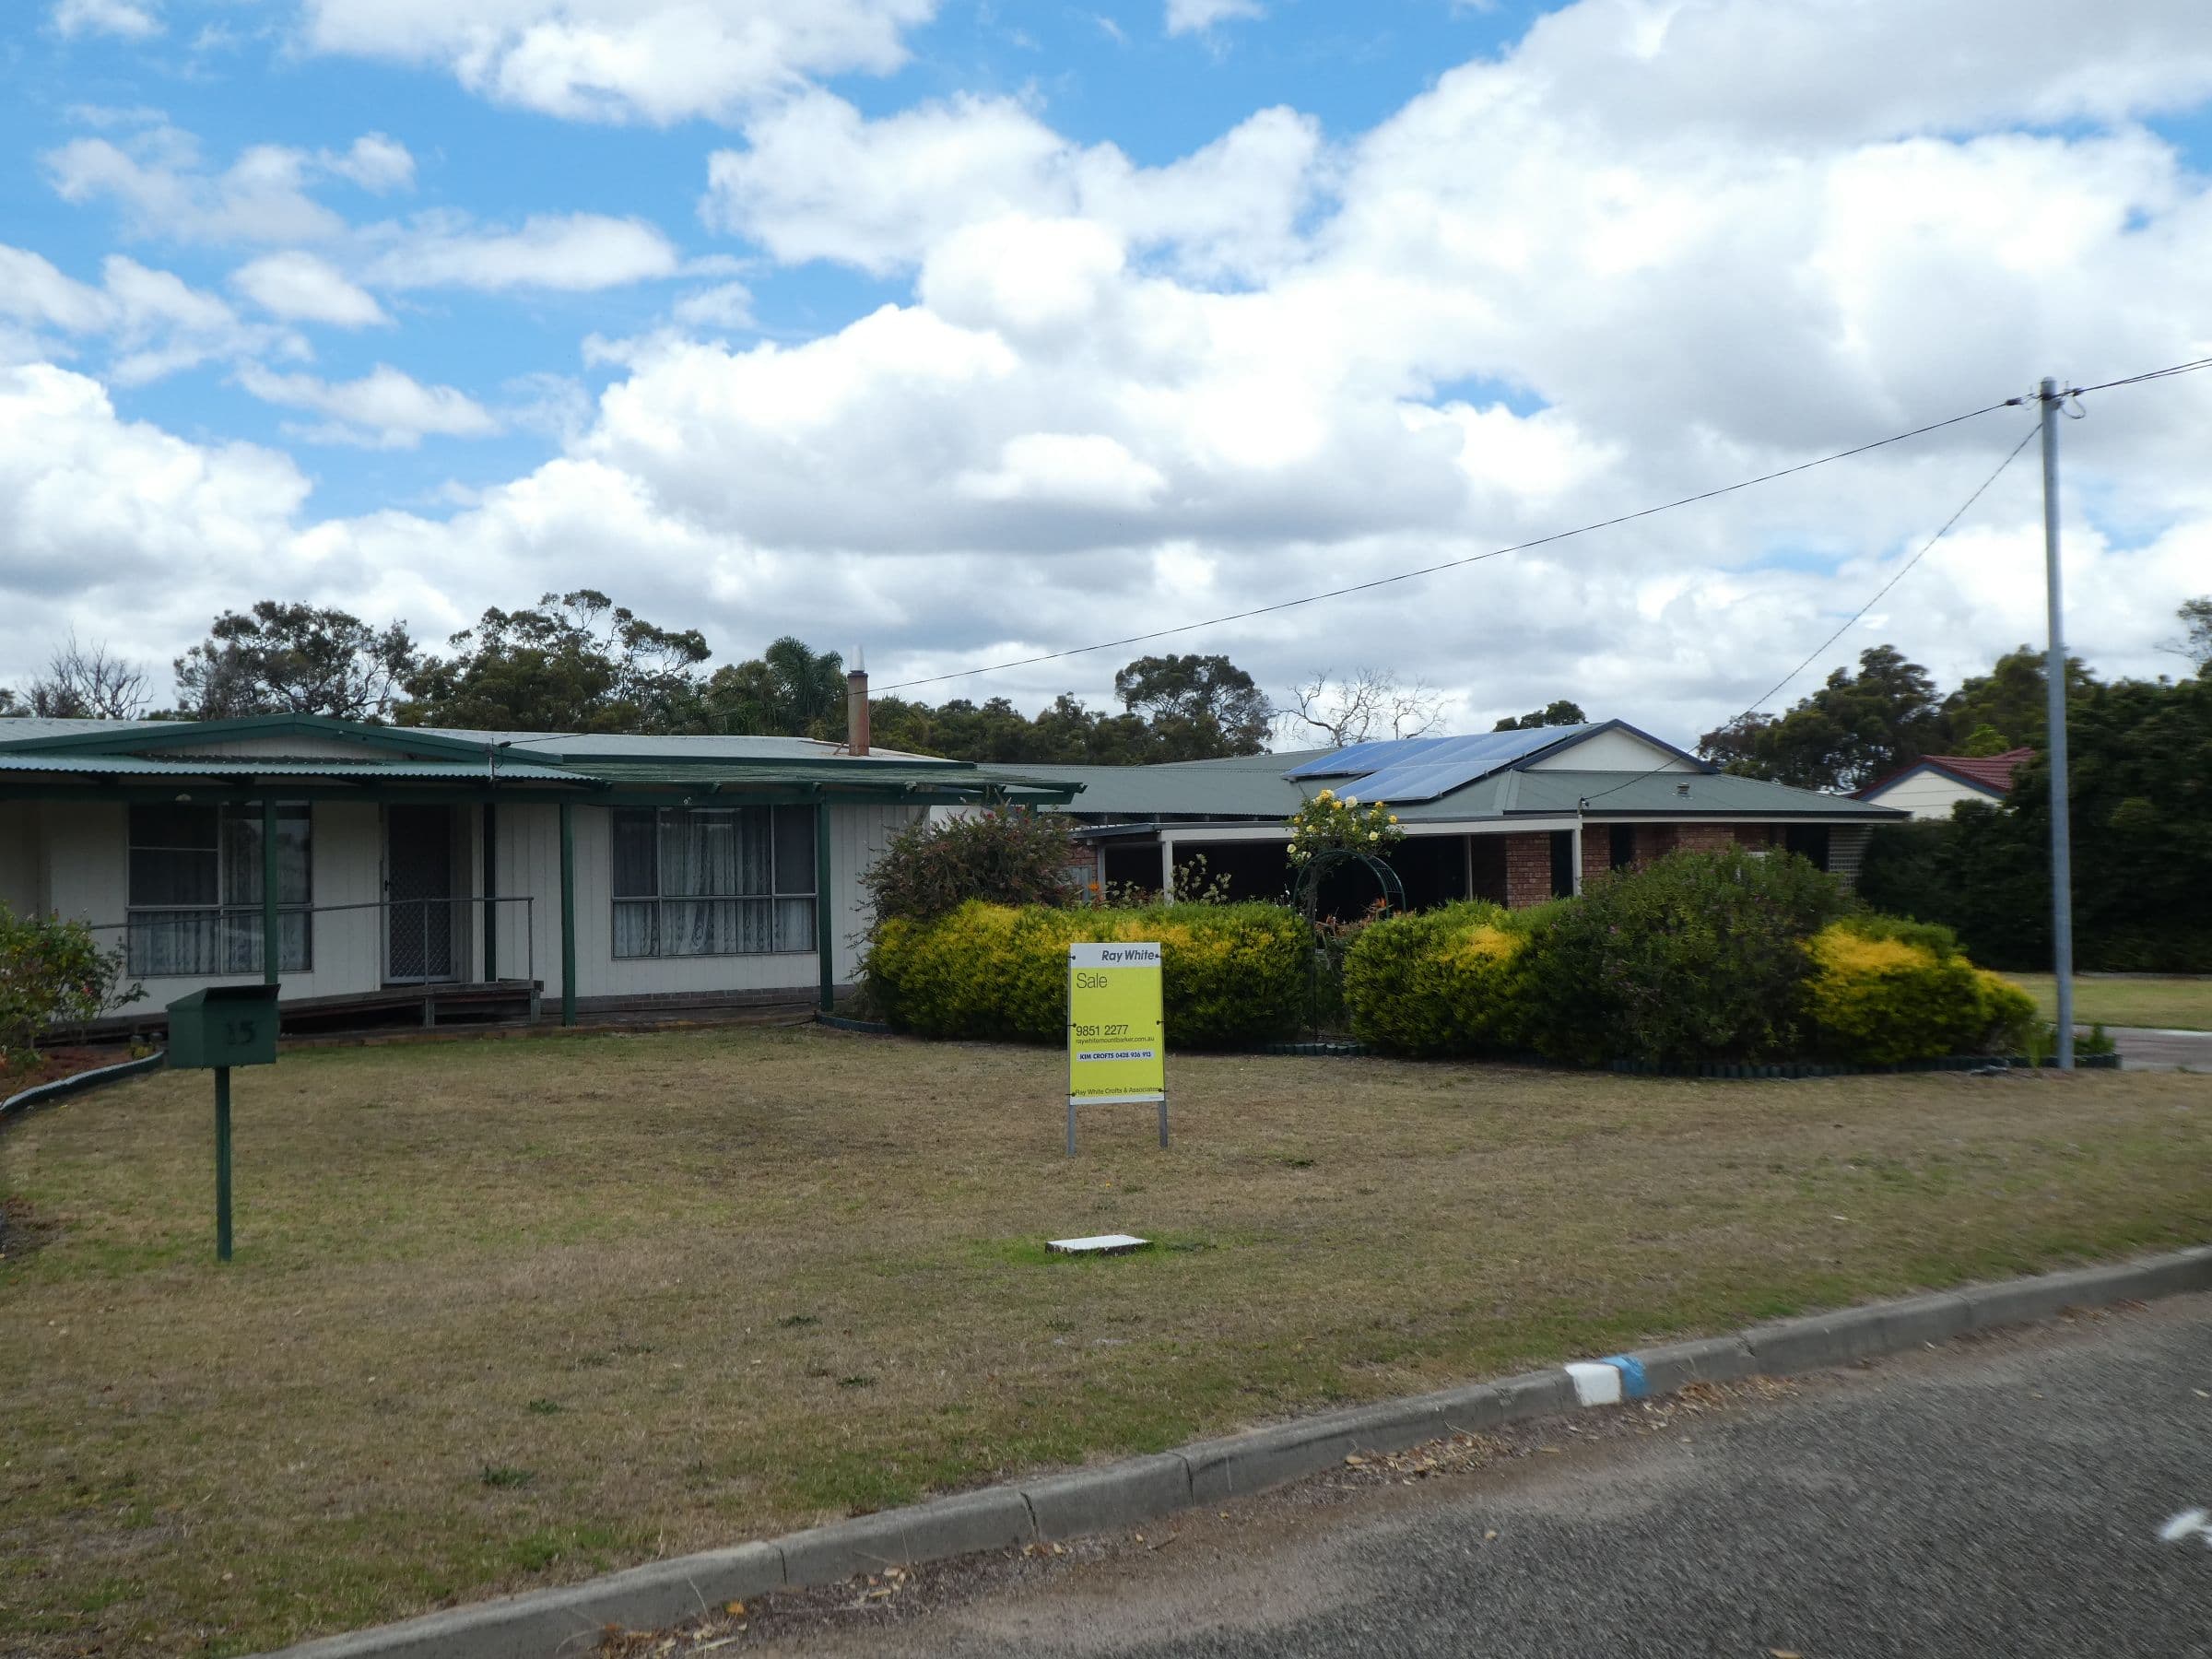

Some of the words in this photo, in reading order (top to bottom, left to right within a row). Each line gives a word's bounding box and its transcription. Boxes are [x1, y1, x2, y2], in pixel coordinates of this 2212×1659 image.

[1101, 950, 1123, 962] Ray
[1124, 949, 1155, 959] White
[1077, 972, 1108, 989] Sale
[225, 1018, 255, 1046] 15
[1076, 1025, 1100, 1036] 9851
[1104, 1024, 1129, 1035] 2277
